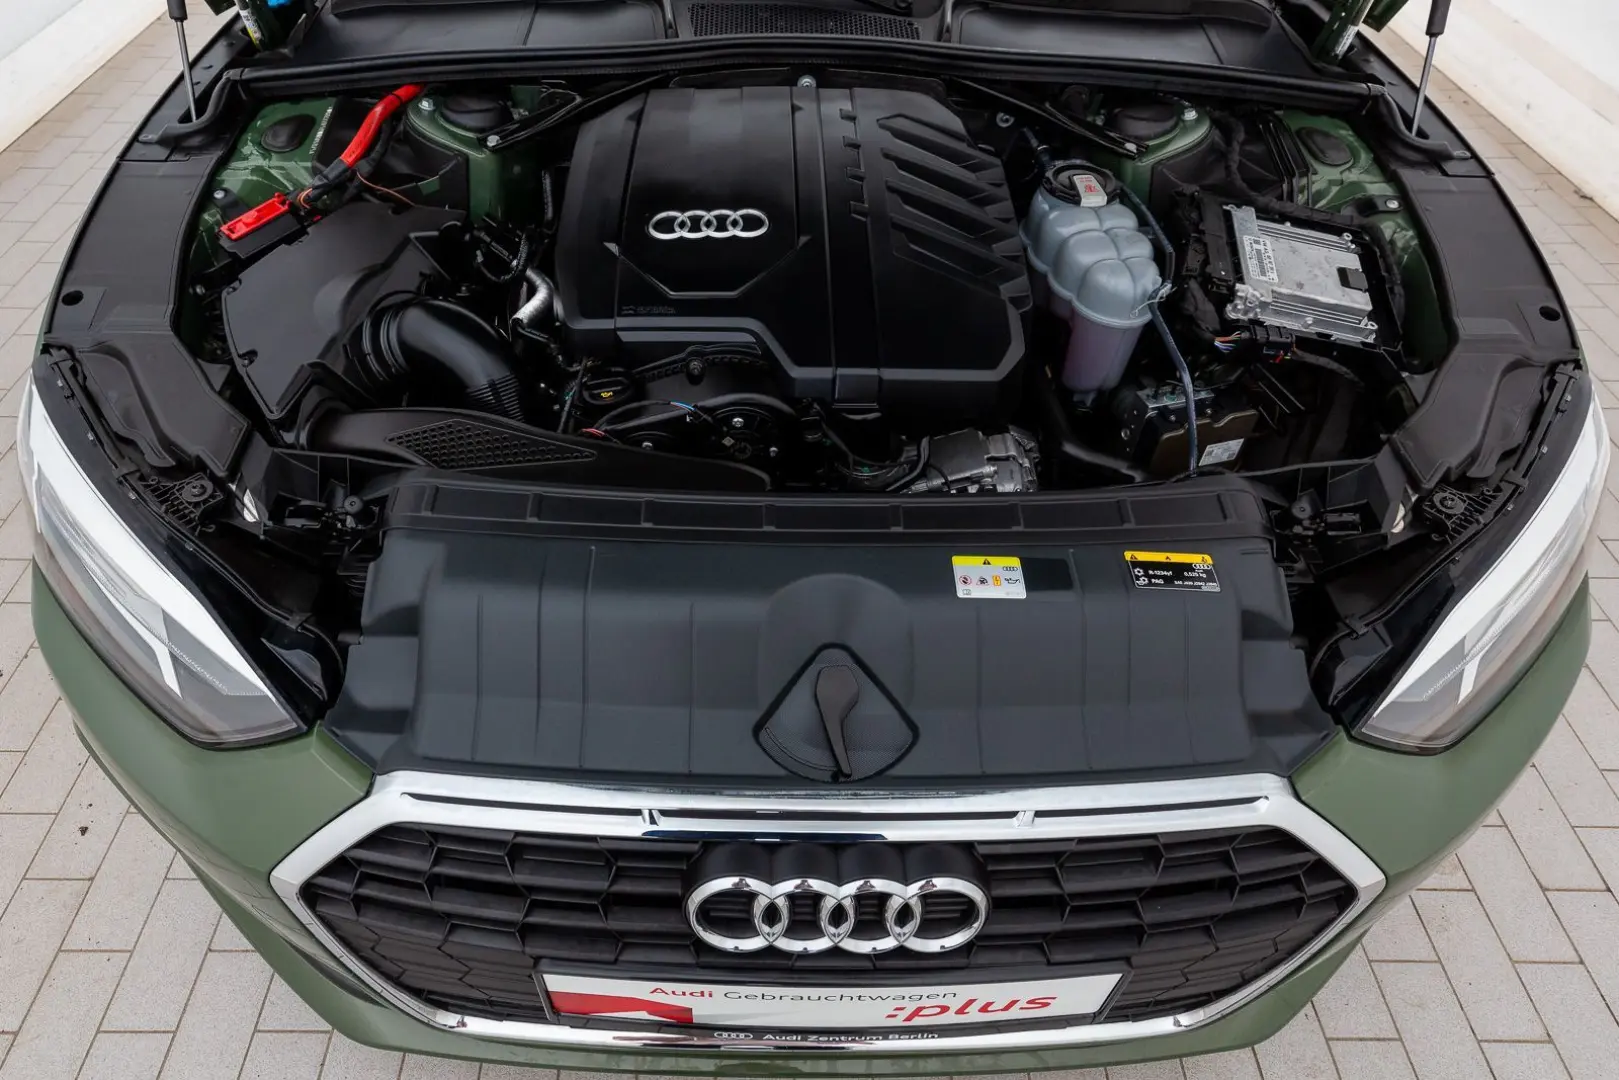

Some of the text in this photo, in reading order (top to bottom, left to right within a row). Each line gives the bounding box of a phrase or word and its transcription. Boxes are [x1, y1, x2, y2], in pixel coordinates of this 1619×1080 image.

[650, 987, 957, 1002] Audi Gebrauchtwagen
[763, 1033, 801, 1041] Audi
[888, 1032, 938, 1040] Berlin
